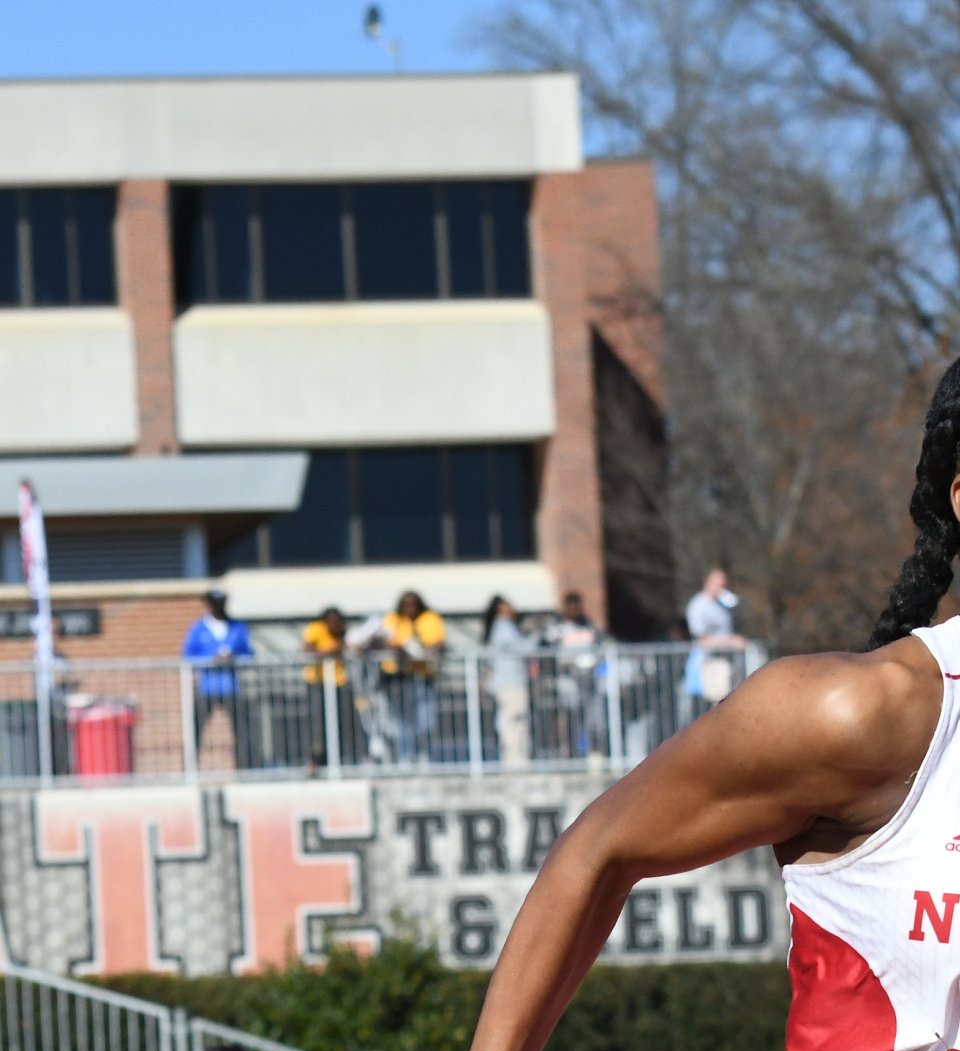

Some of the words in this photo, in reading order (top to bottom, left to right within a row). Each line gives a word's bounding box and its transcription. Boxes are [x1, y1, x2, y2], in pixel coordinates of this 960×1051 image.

[0, 783, 381, 977] TE
[397, 809, 566, 877] TRA
[450, 895, 499, 960] &
[601, 886, 772, 953] ELD
